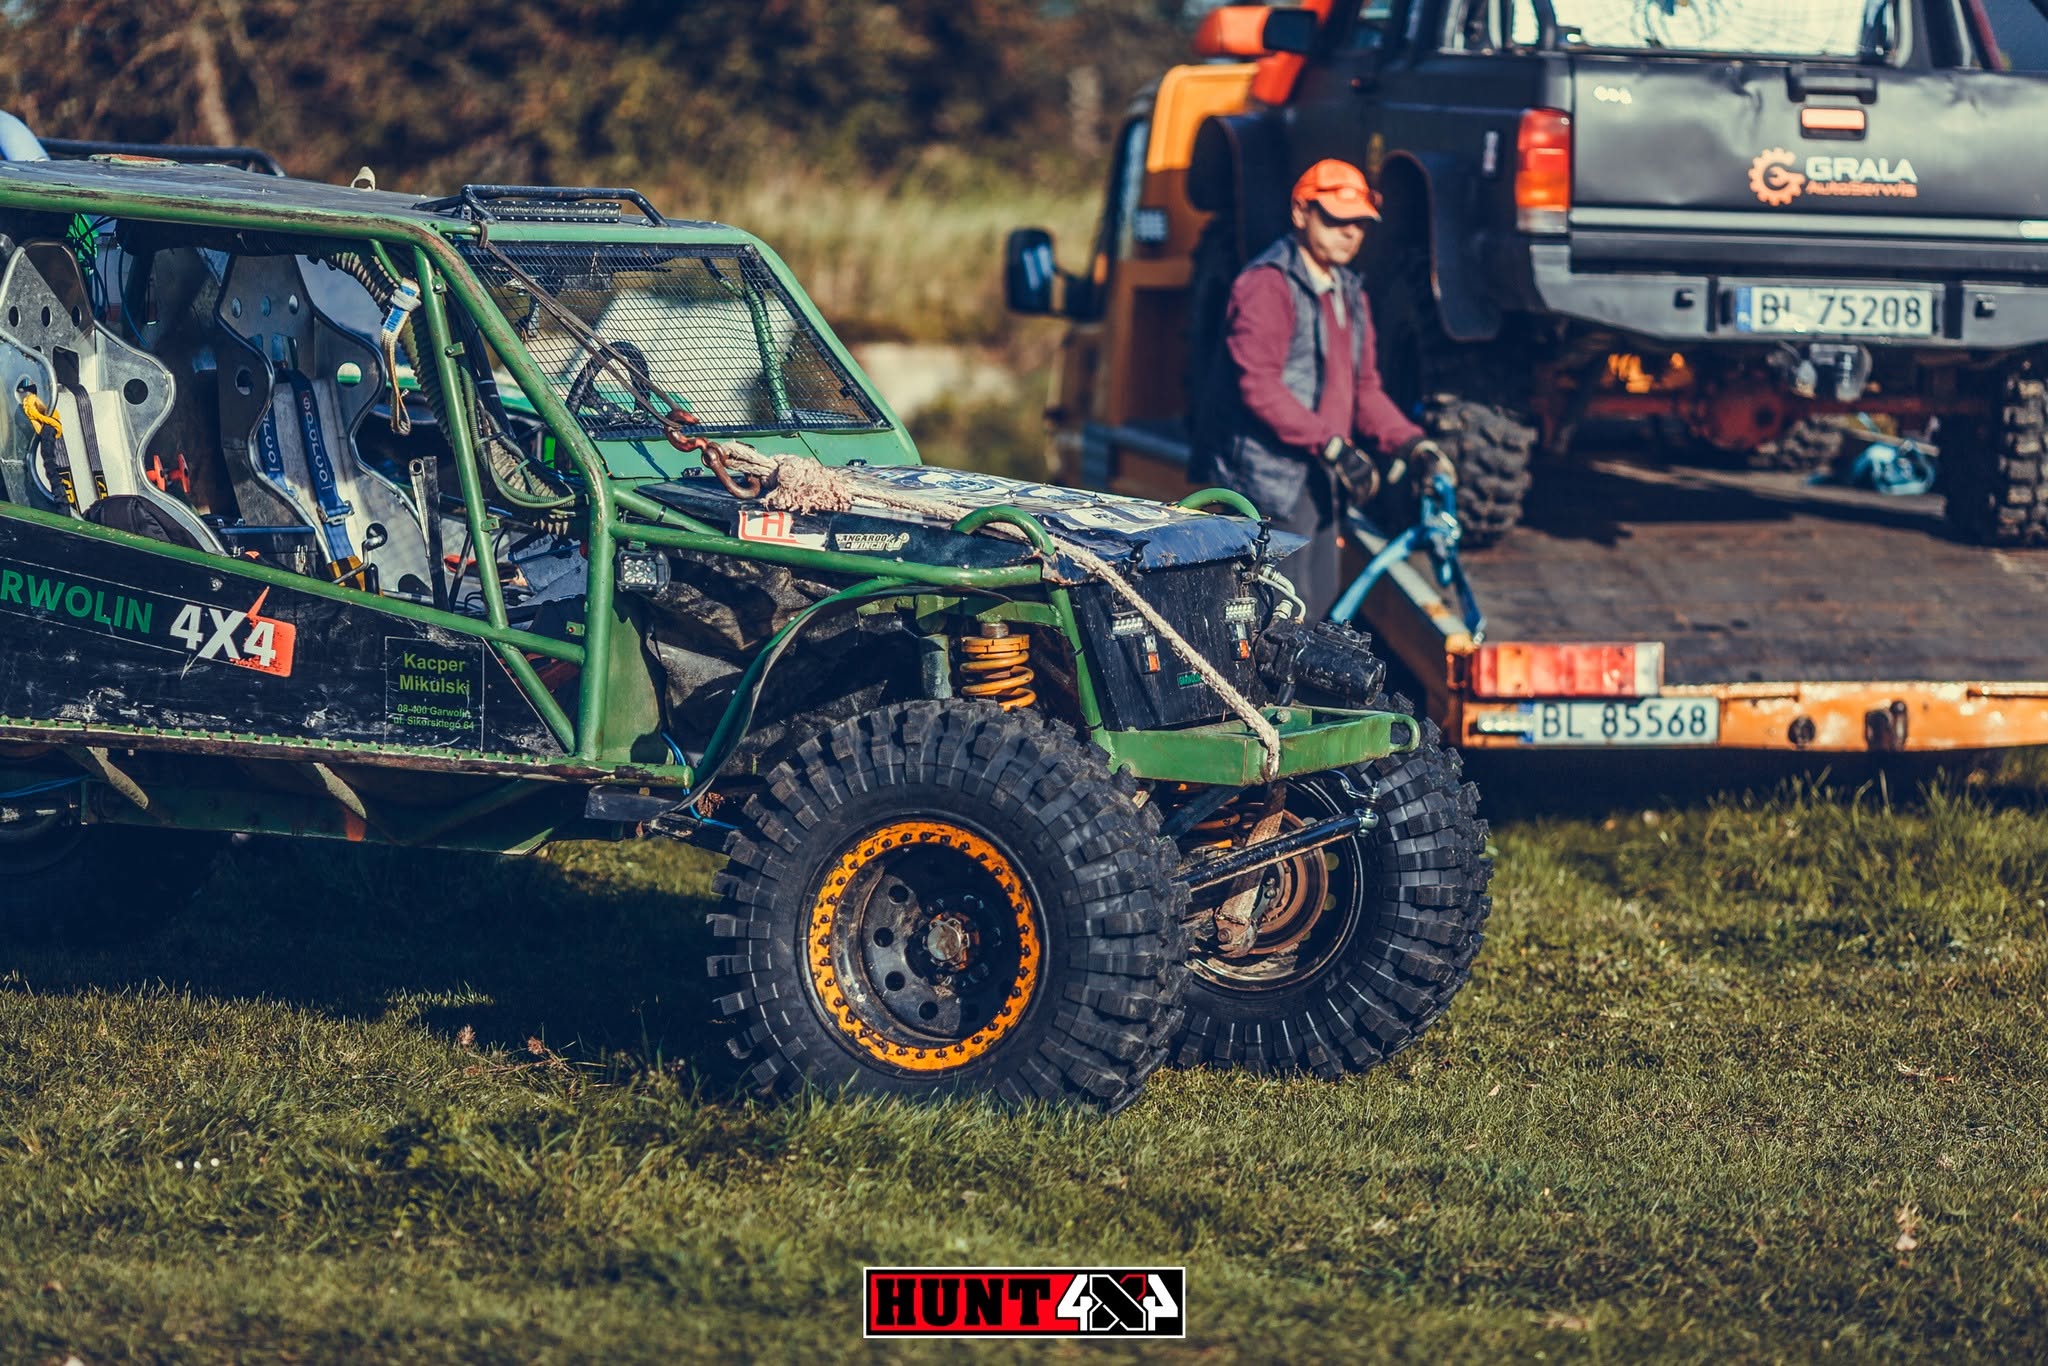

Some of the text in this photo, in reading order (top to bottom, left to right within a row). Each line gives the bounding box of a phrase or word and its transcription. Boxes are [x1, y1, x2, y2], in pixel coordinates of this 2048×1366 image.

[1805, 156, 1918, 183] GRALA
[1817, 295, 1921, 328] 75208
[837, 534, 887, 543] ANGAROO
[403, 652, 466, 674] Kacper
[399, 674, 471, 694] Mikulski
[397, 703, 428, 714] 08-400
[406, 716, 461, 731] Sikorskiego
[463, 721, 475, 732] 64
[1541, 702, 1708, 738] BL 85568
